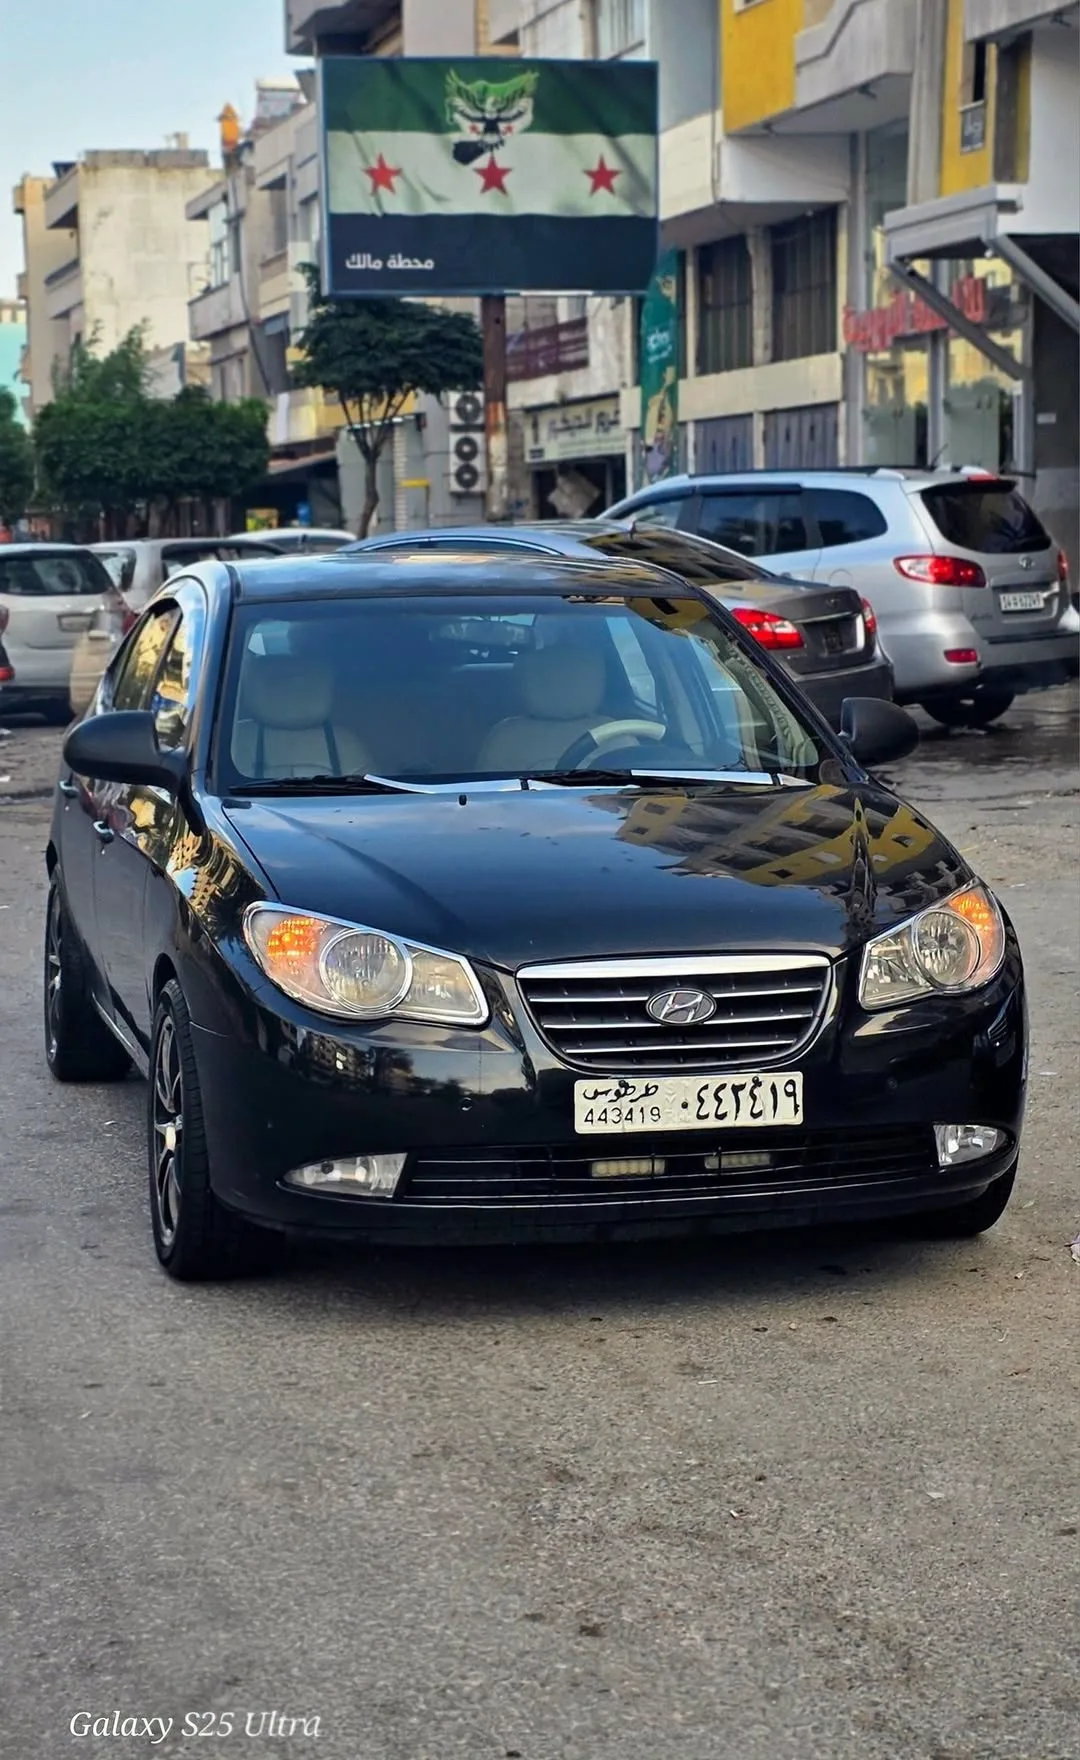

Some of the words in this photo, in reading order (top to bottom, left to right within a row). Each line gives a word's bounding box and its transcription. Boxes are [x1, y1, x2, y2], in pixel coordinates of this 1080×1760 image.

[345, 253, 383, 270] مالك
[386, 254, 435, 270] محطة
[584, 1106, 661, 1125] 443419
